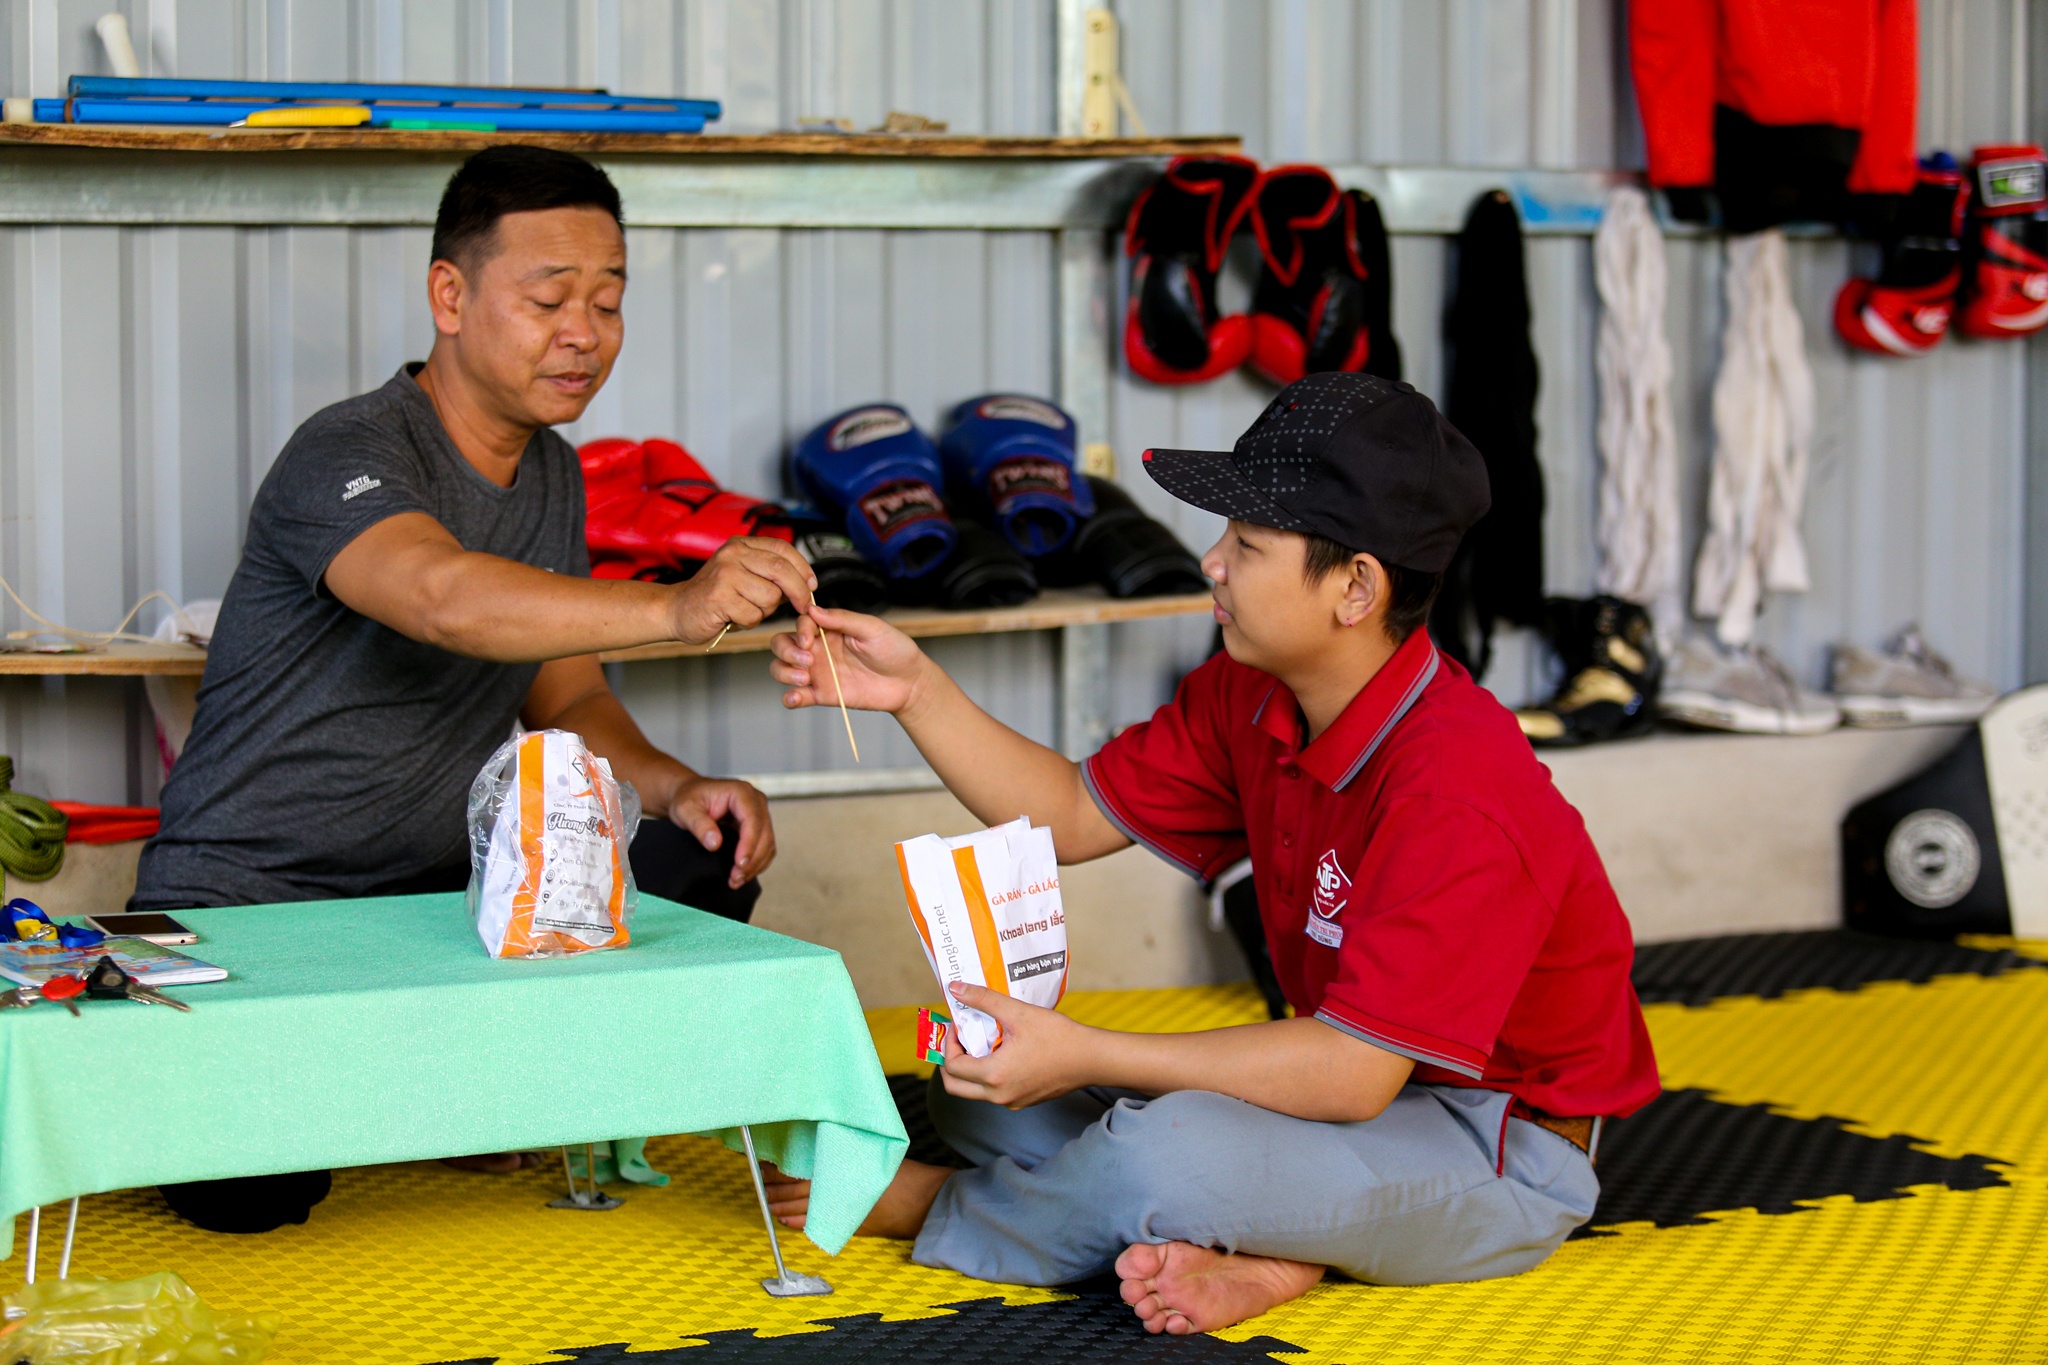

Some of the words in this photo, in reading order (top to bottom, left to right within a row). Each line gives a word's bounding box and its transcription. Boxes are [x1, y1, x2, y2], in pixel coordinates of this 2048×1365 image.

[1316, 862, 1341, 891] NTP
[991, 892, 1007, 906] GÀ
[1006, 887, 1022, 902] RÁN
[1028, 882, 1041, 895] GÀ
[999, 927, 1025, 942] Khoai
[1025, 919, 1048, 934] lang
[1026, 962, 1041, 972] hàng
